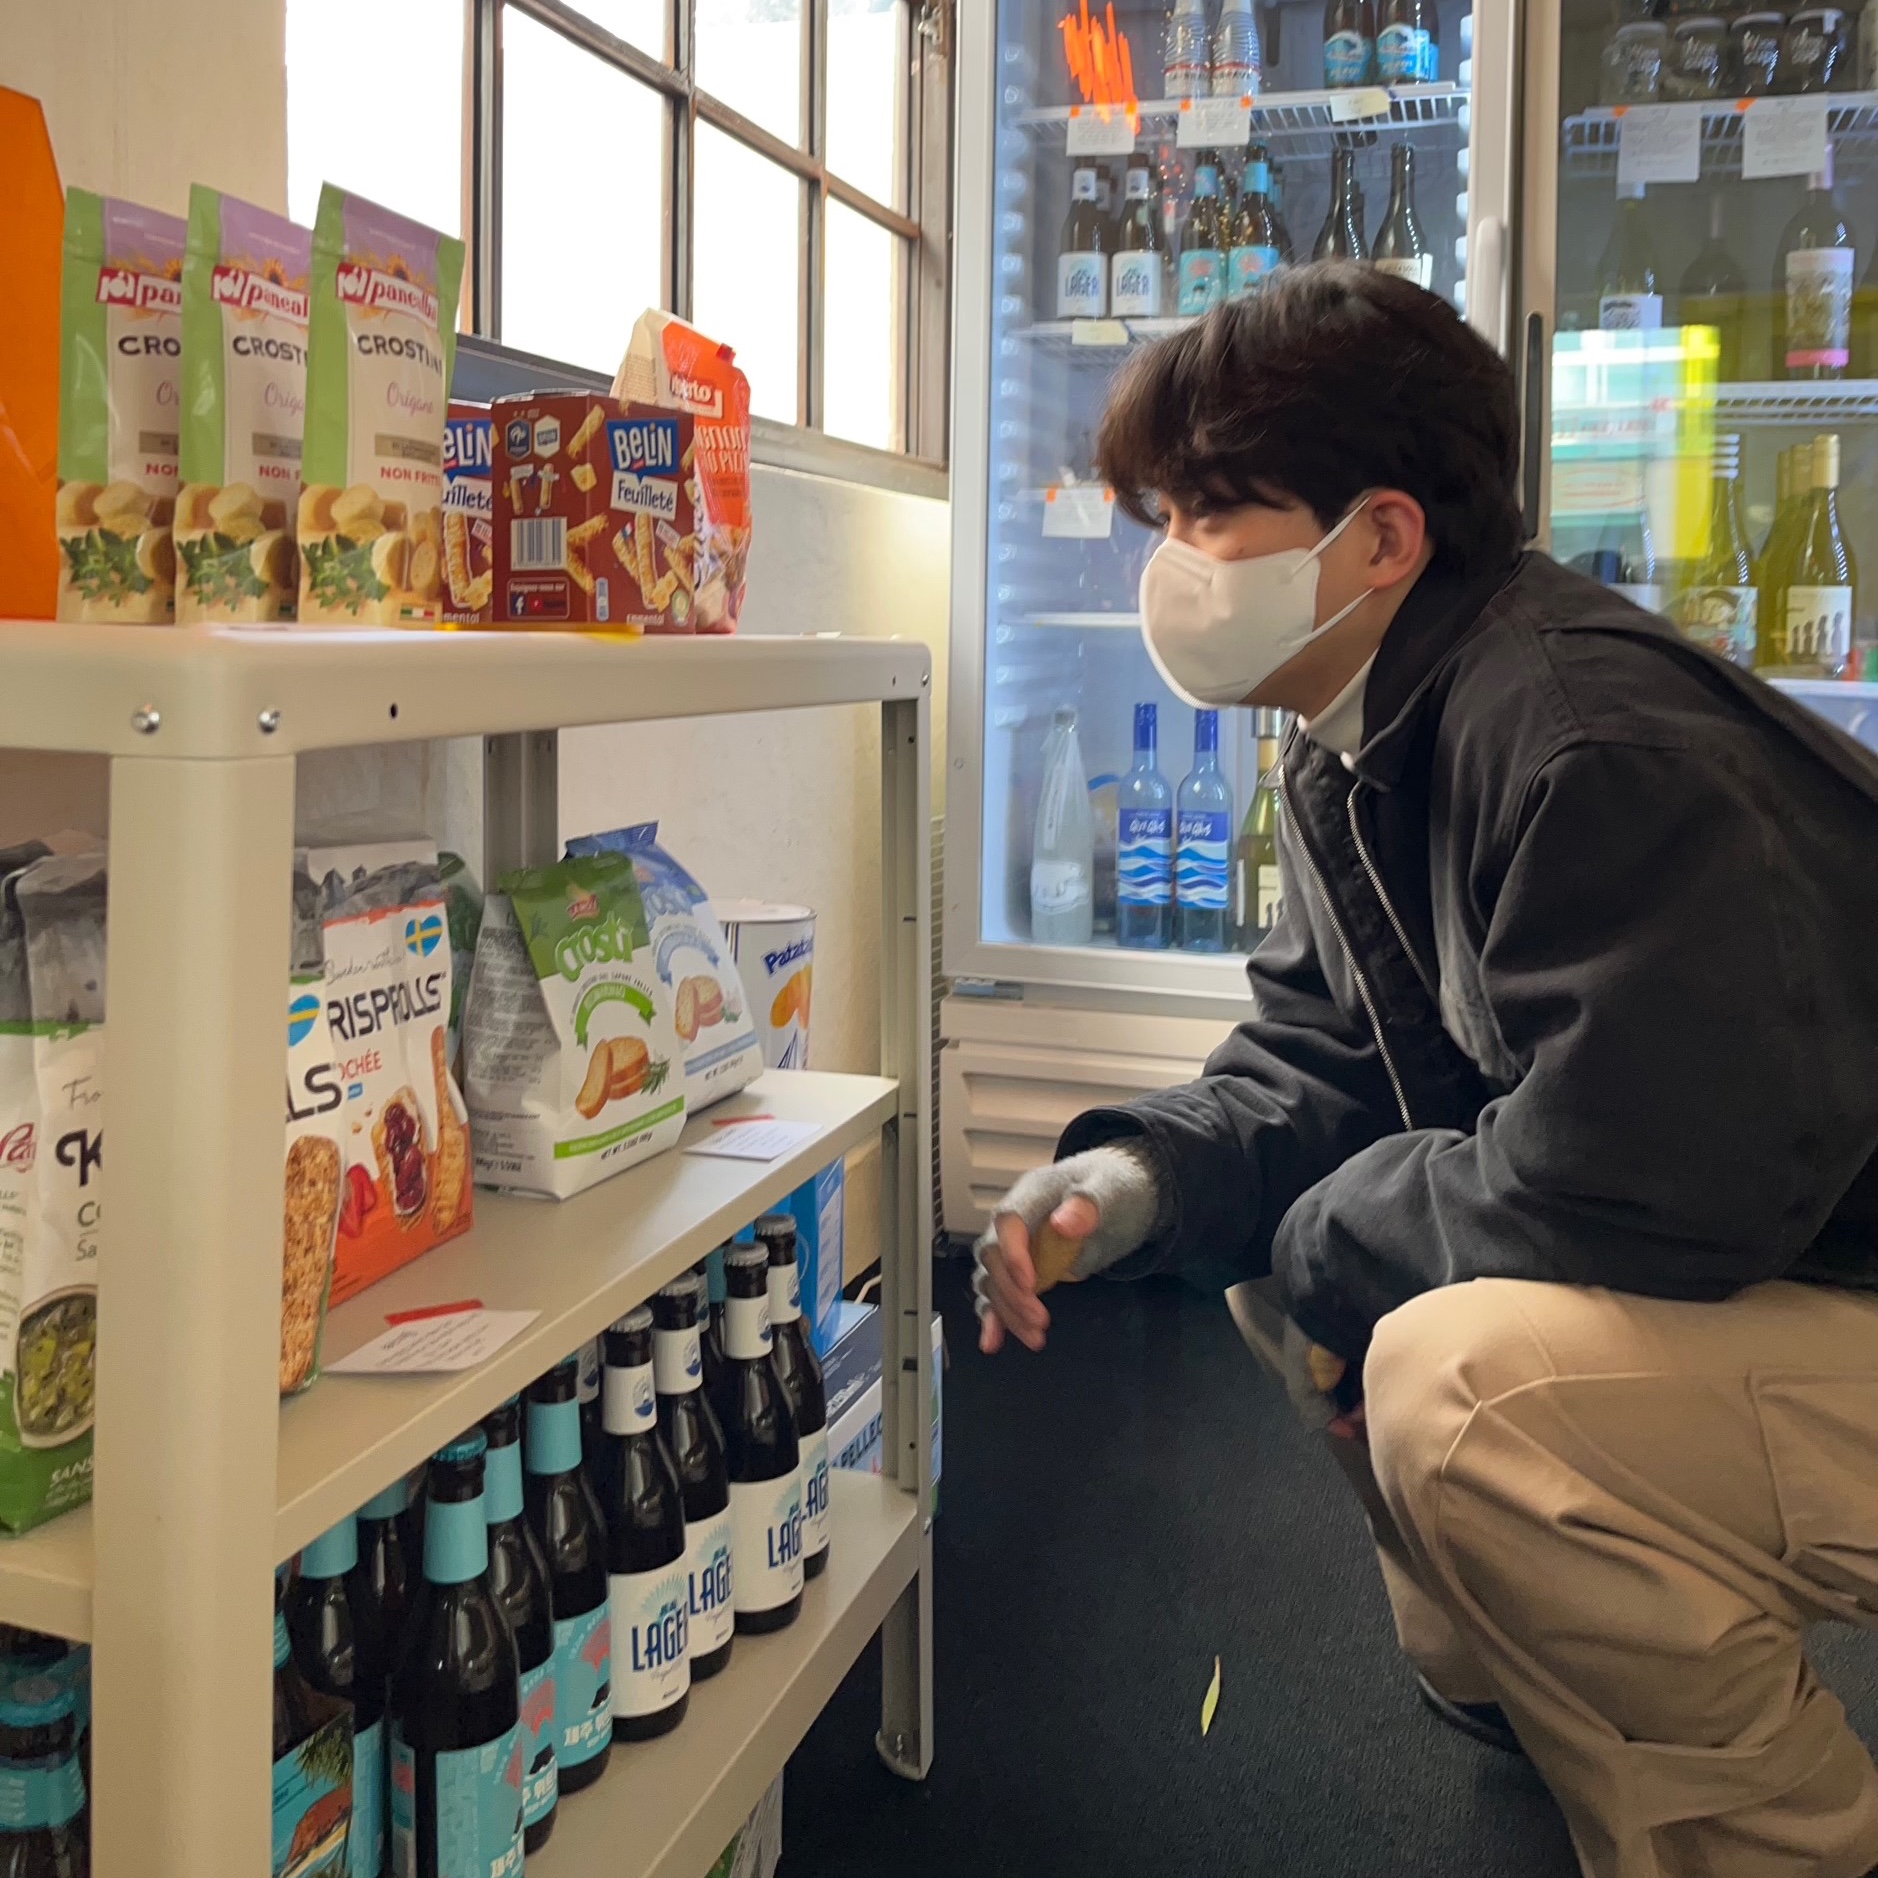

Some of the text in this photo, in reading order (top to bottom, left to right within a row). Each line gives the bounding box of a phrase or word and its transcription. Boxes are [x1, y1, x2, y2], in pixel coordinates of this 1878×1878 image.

[118, 335, 182, 357] CRO
[380, 466, 412, 482] NON
[617, 480, 674, 513] Feuilleté
